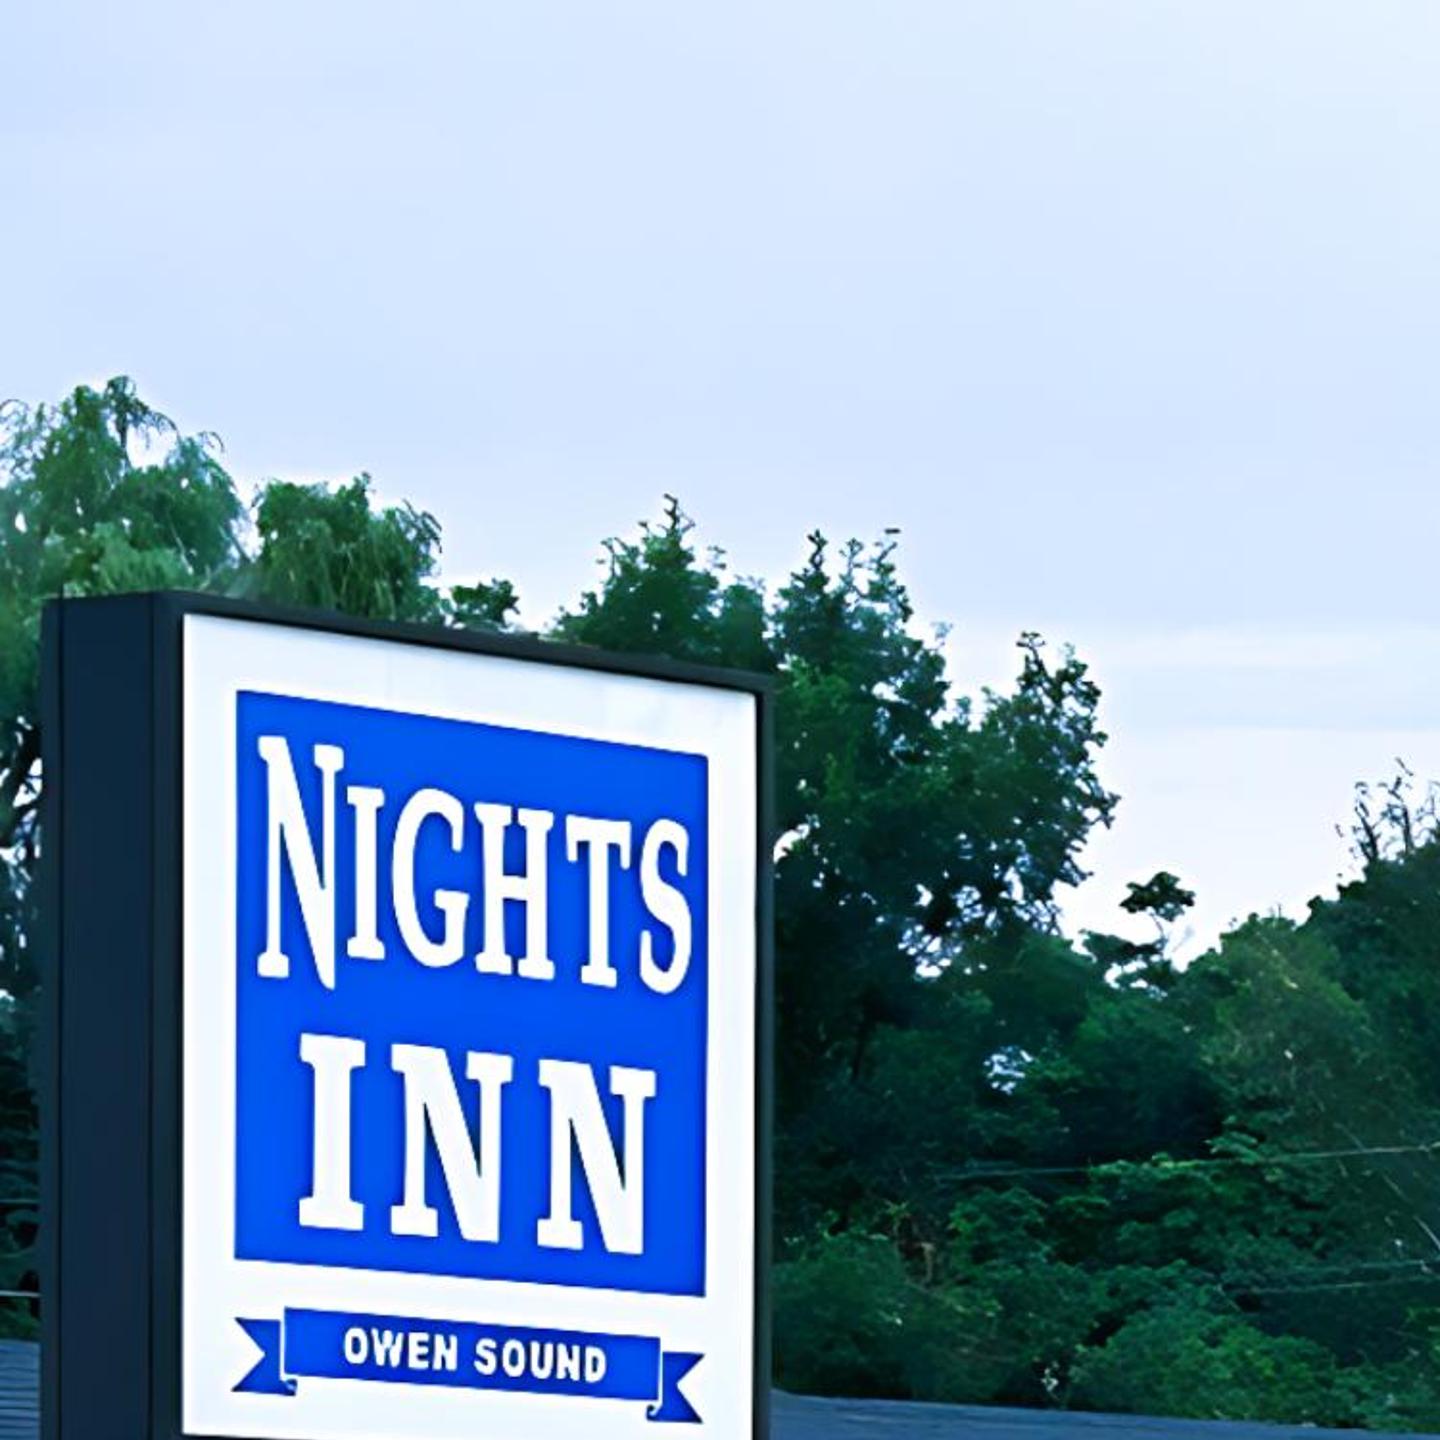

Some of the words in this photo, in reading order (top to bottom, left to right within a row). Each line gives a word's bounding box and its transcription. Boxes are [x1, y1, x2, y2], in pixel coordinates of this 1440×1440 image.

[257, 734, 694, 993] NIGHTS
[299, 1032, 656, 1255] INN
[344, 1326, 459, 1371] OWEN
[474, 1337, 608, 1383] SOUND
